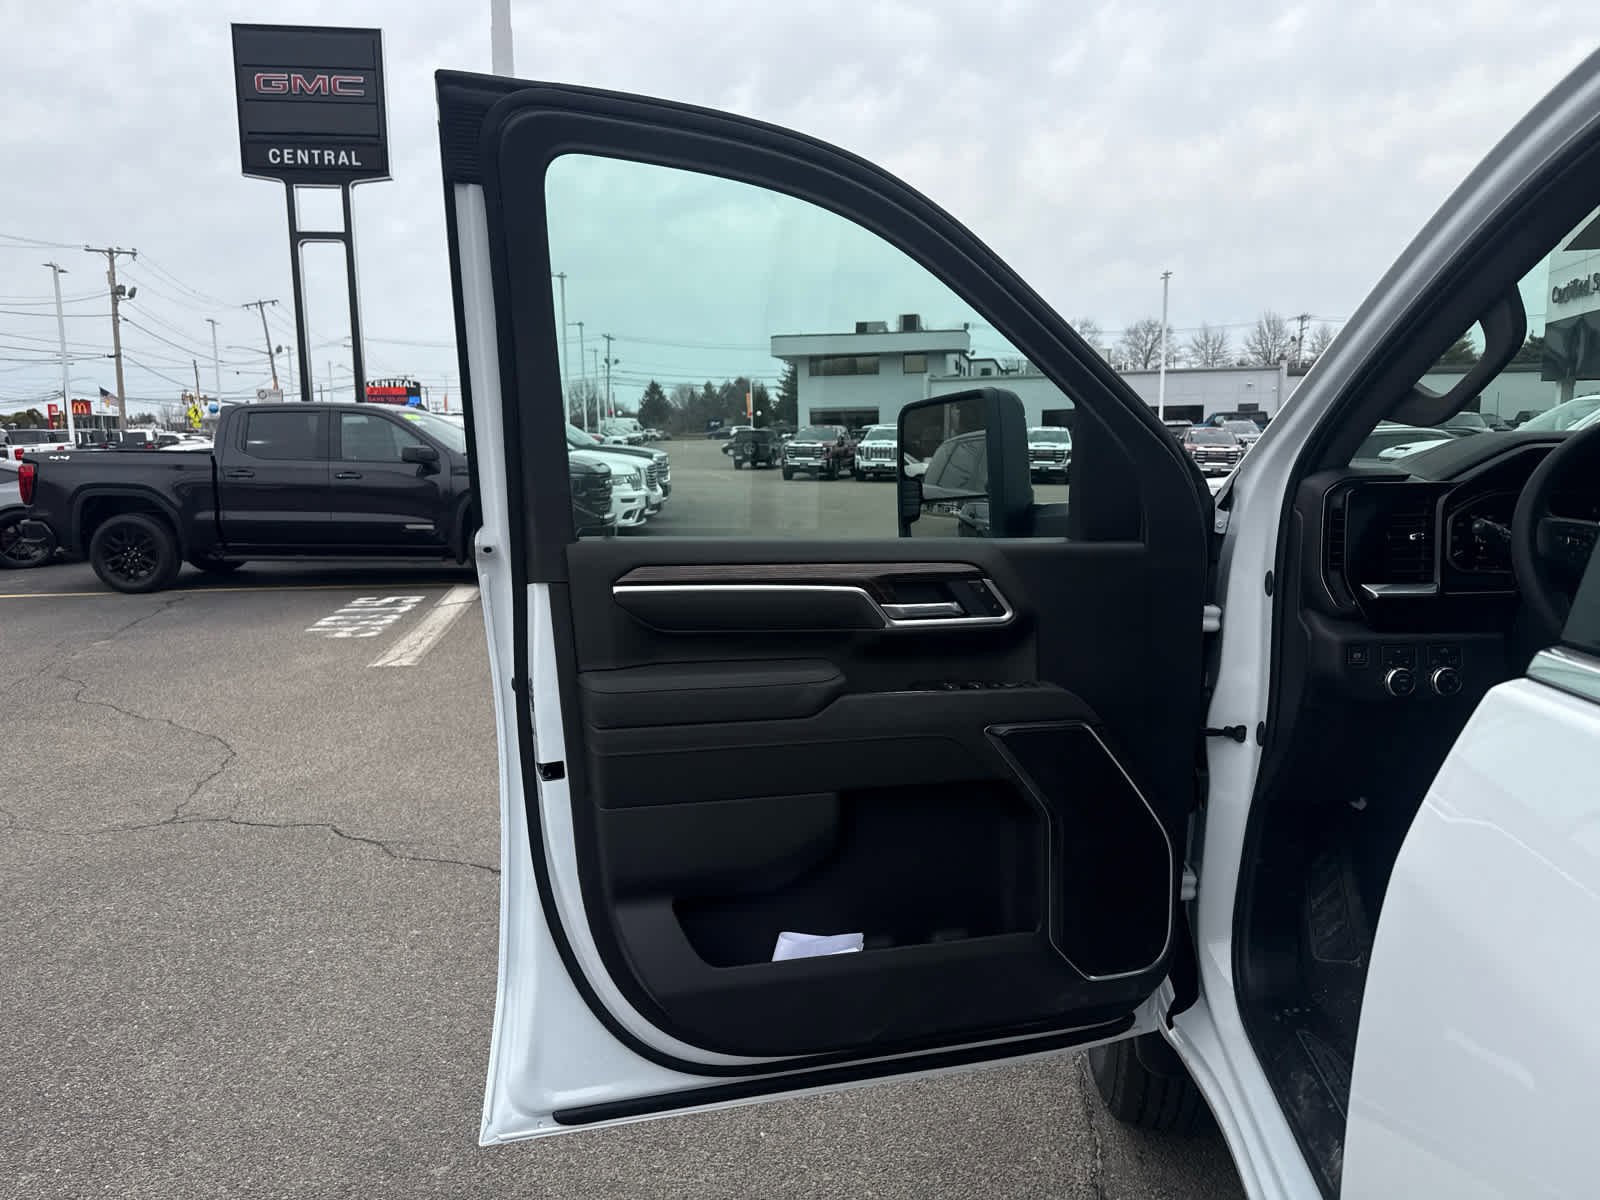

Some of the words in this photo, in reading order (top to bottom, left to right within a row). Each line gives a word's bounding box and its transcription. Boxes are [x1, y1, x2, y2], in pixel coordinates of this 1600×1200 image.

[254, 72, 365, 96] GMC
[268, 148, 362, 166] CENTRAL
[368, 379, 416, 388] CENTRAL
